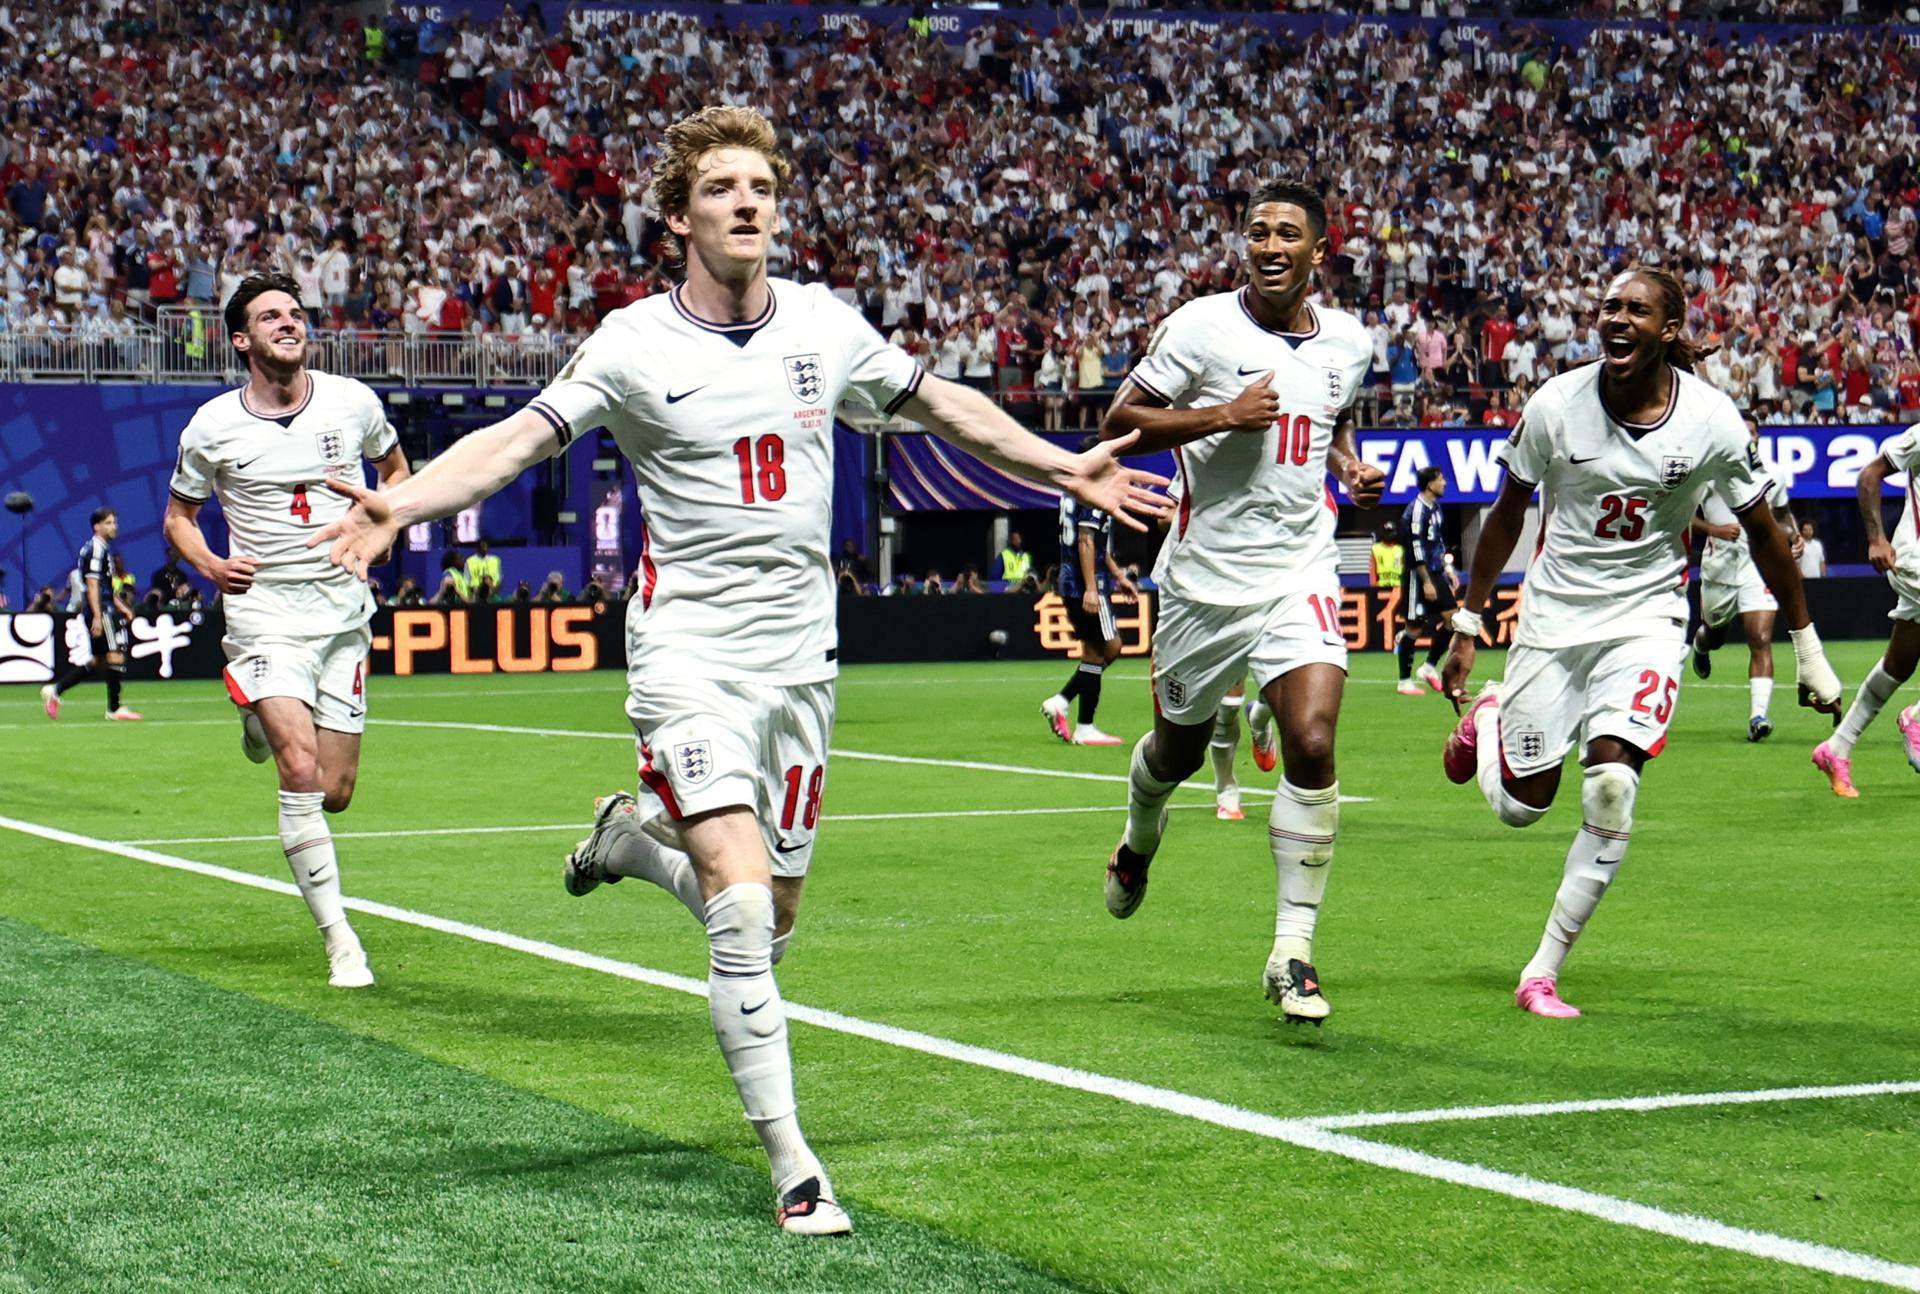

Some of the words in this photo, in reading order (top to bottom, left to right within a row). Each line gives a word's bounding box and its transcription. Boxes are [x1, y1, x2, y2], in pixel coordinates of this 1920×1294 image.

[929, 16, 959, 32] 09C
[1276, 413, 1311, 466] 10
[733, 433, 786, 504] 18
[289, 484, 311, 524] 4
[1594, 495, 1648, 541] 25
[366, 607, 598, 674] -PLUS
[352, 661, 362, 703] 4
[1631, 670, 1677, 724] 25
[780, 765, 823, 830] 18
